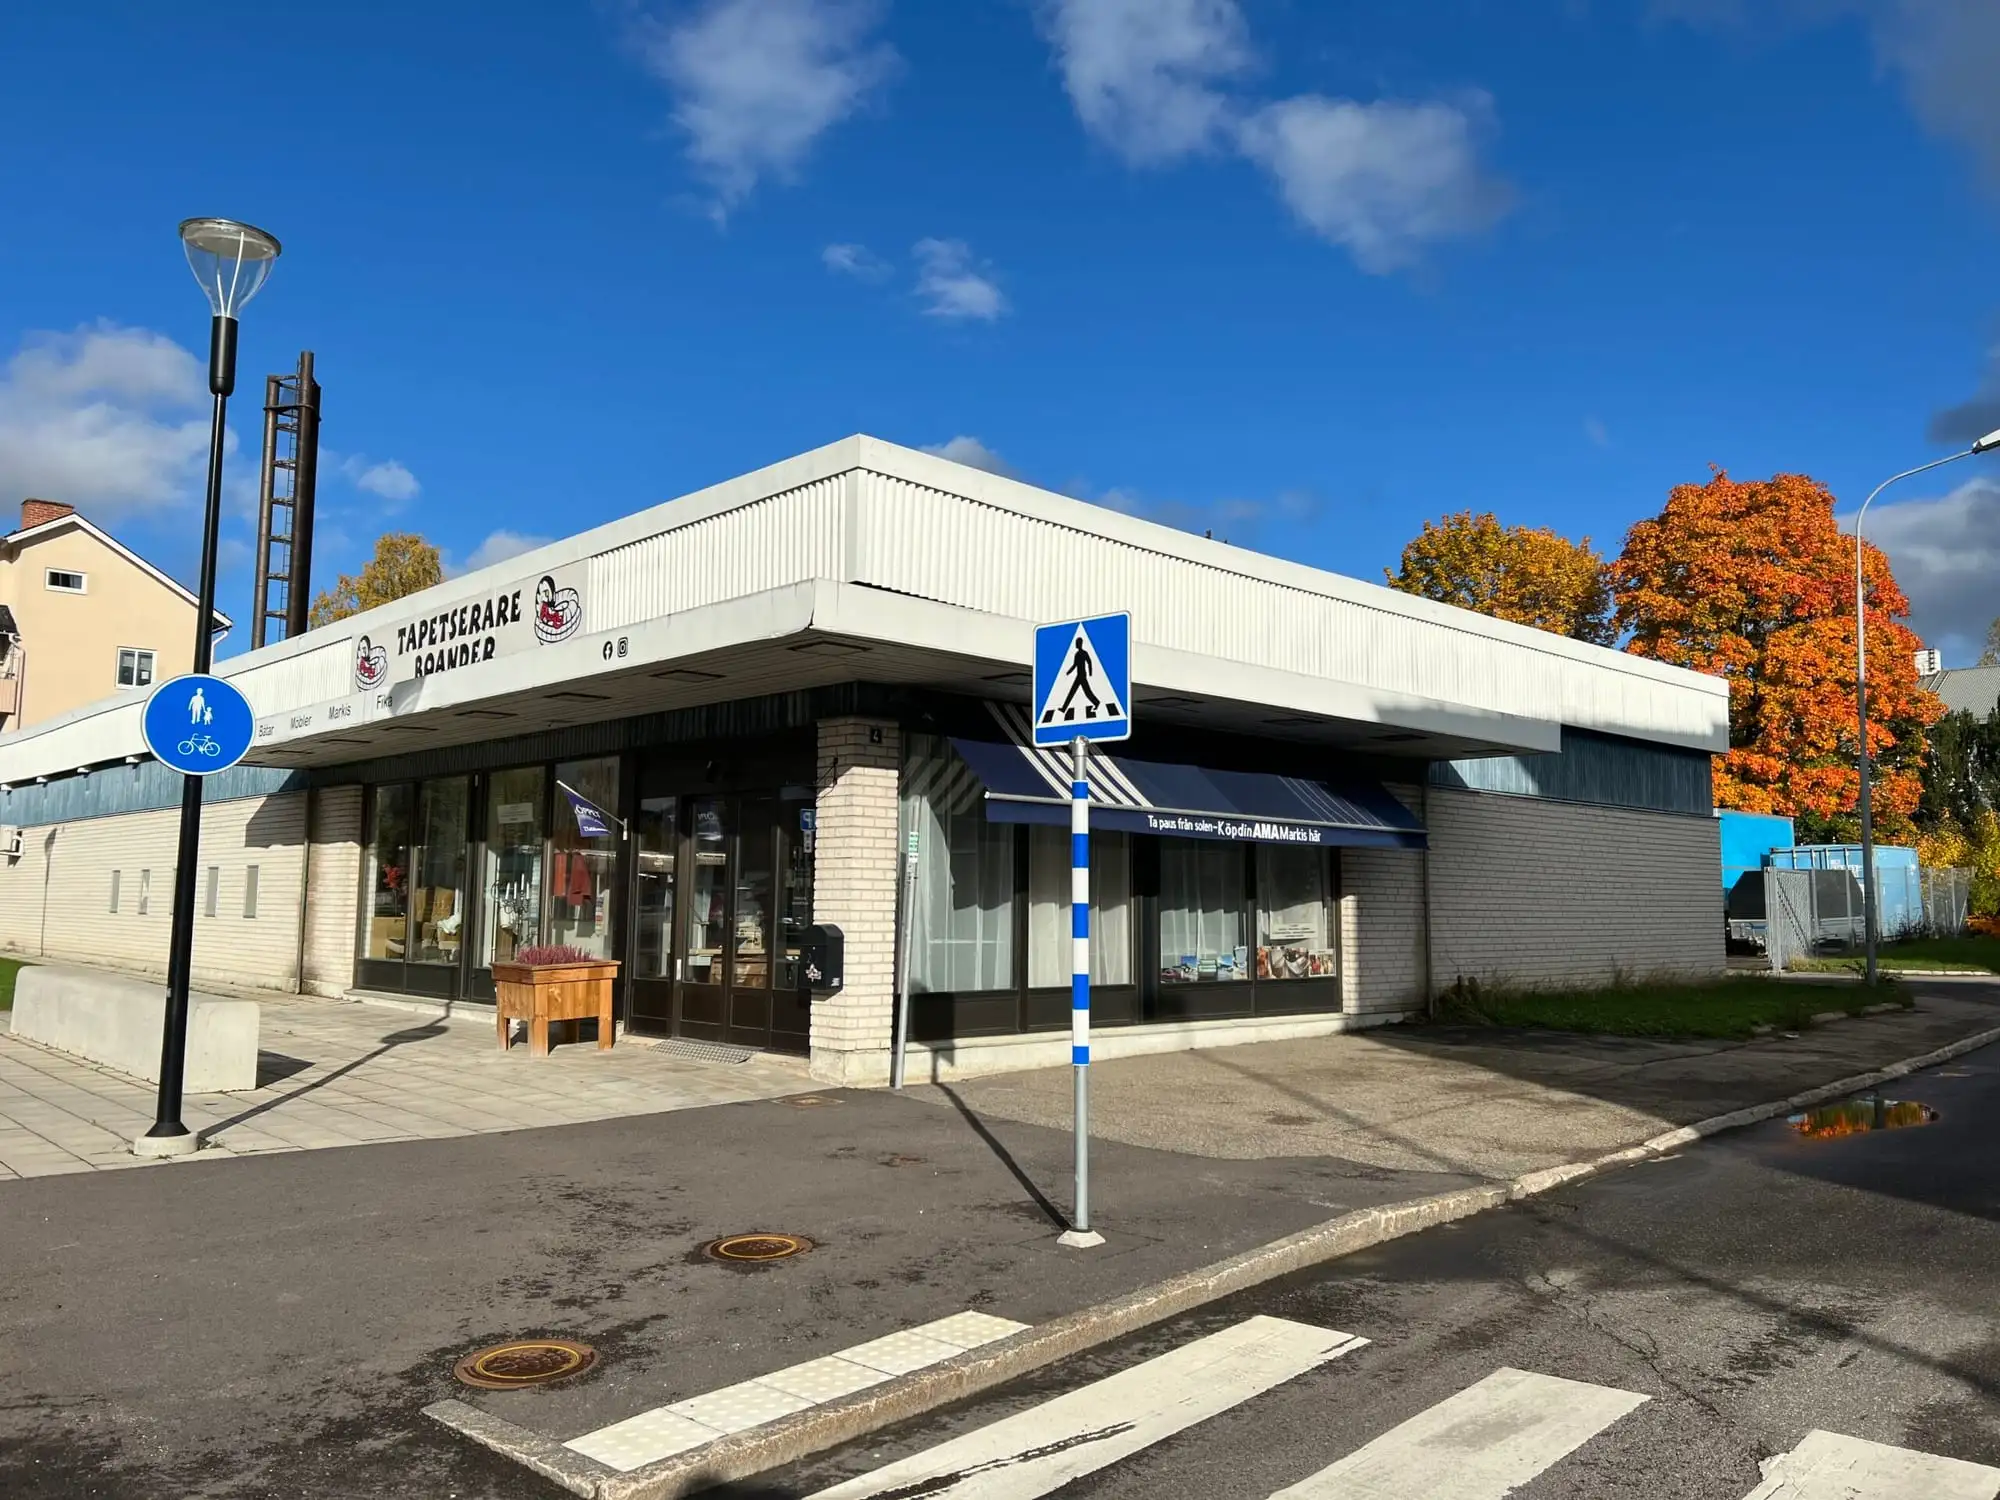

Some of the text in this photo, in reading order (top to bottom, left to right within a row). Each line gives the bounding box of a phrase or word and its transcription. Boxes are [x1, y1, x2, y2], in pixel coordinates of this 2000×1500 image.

[397, 590, 521, 655] TAPETSERARE
[328, 703, 351, 720] Markis
[376, 694, 393, 710] Fika
[1148, 815, 1158, 828] Ta
[1159, 819, 1177, 831] paus
[1177, 817, 1194, 831] från
[1252, 823, 1280, 840] AMA
[1280, 826, 1307, 841] Markis
[1308, 828, 1321, 842] här
